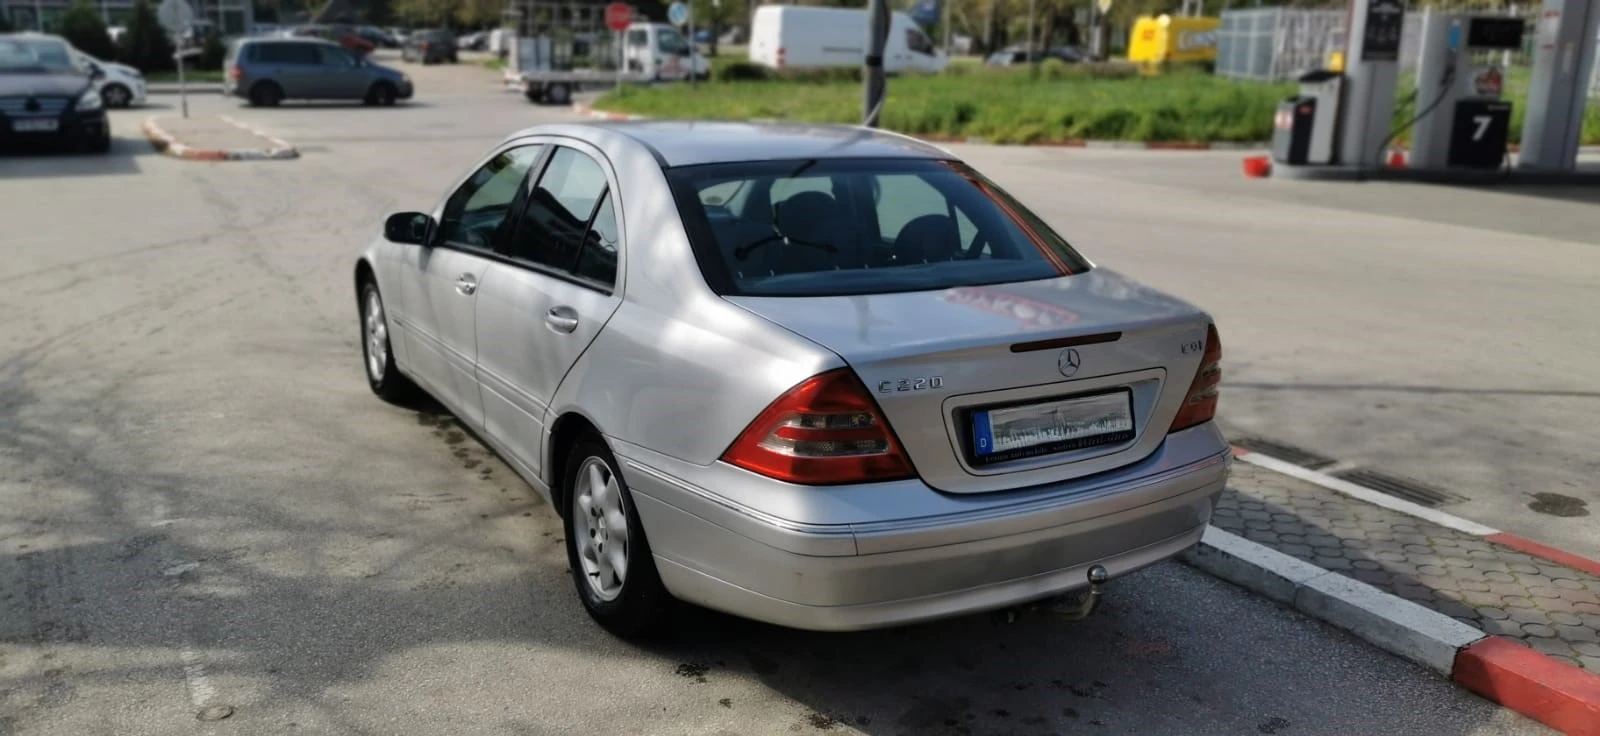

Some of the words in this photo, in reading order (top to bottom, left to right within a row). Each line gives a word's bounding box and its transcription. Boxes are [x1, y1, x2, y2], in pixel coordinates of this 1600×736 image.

[1472, 114, 1493, 142] 7
[878, 380, 892, 394] C
[897, 376, 944, 392] 220
[980, 438, 987, 448] D
